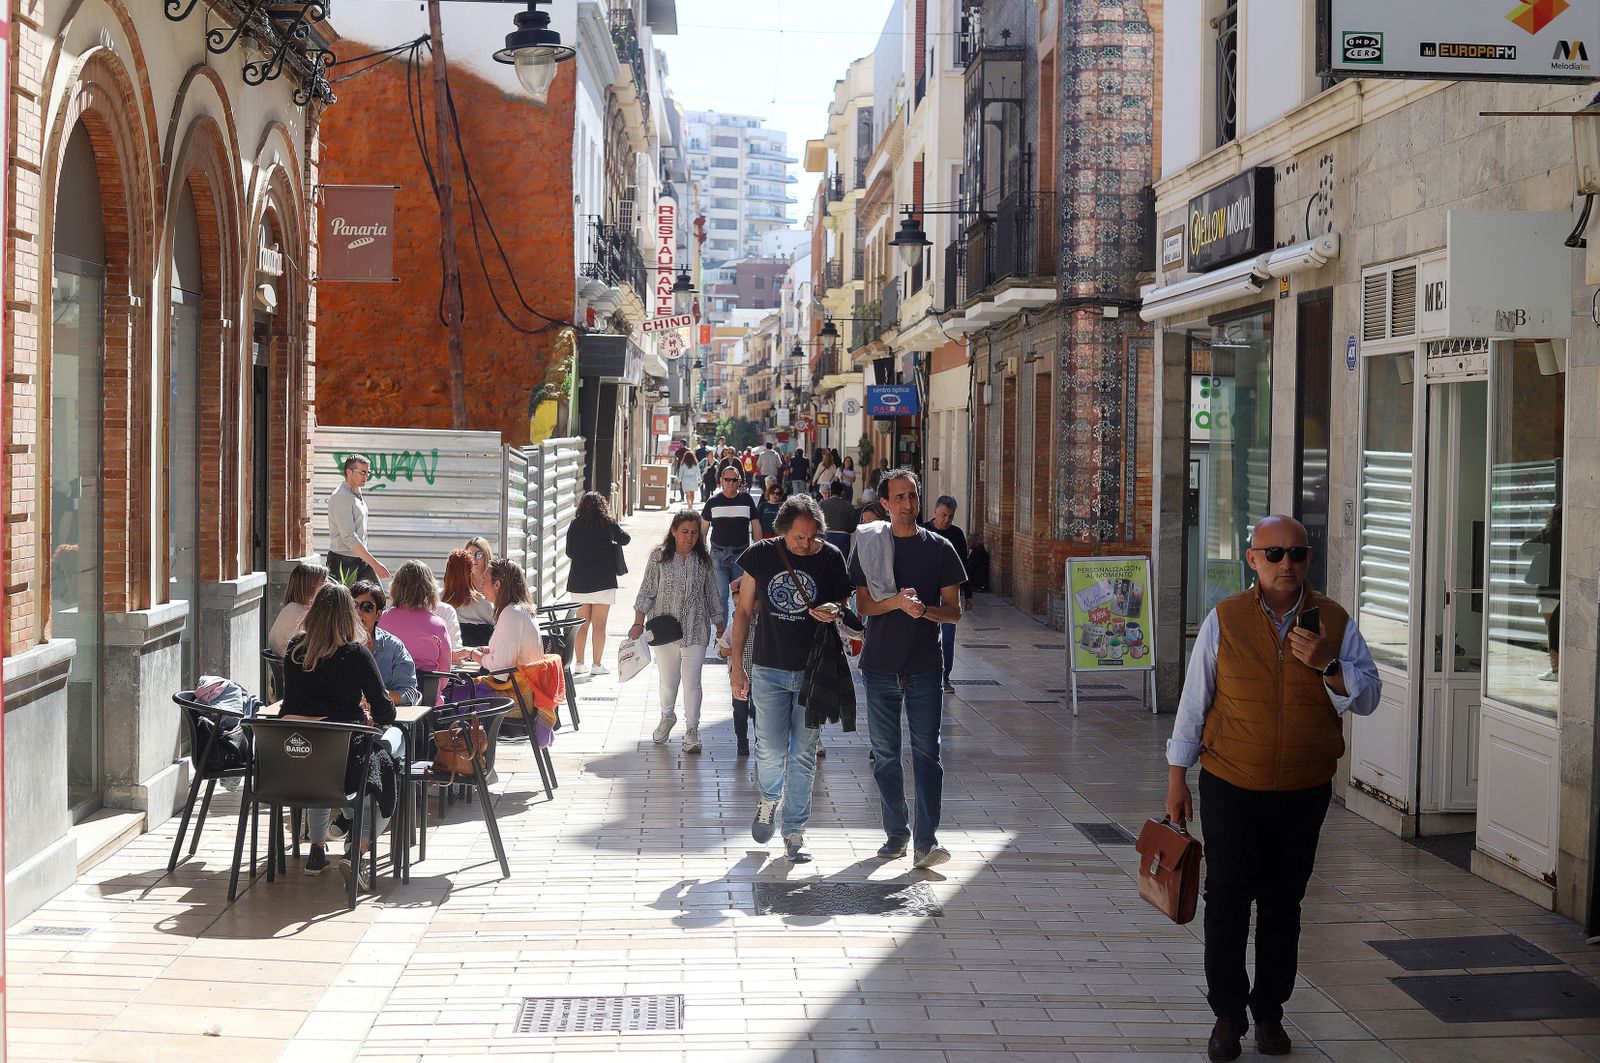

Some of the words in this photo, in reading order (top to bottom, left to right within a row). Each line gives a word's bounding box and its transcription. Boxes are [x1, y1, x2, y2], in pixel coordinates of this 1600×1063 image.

[1347, 37, 1379, 47] ONDA
[1349, 49, 1377, 57] CERO
[331, 217, 388, 236] Panaria
[657, 205, 674, 316] RESTAURANTE
[1424, 280, 1447, 312] ME
[642, 314, 692, 333] CHINO
[872, 405, 911, 414] PASUAL
[1077, 564, 1141, 574] PERSONALIZACIÓN
[1096, 571, 1133, 579] MOMENTO
[286, 745, 310, 753] BARCO
